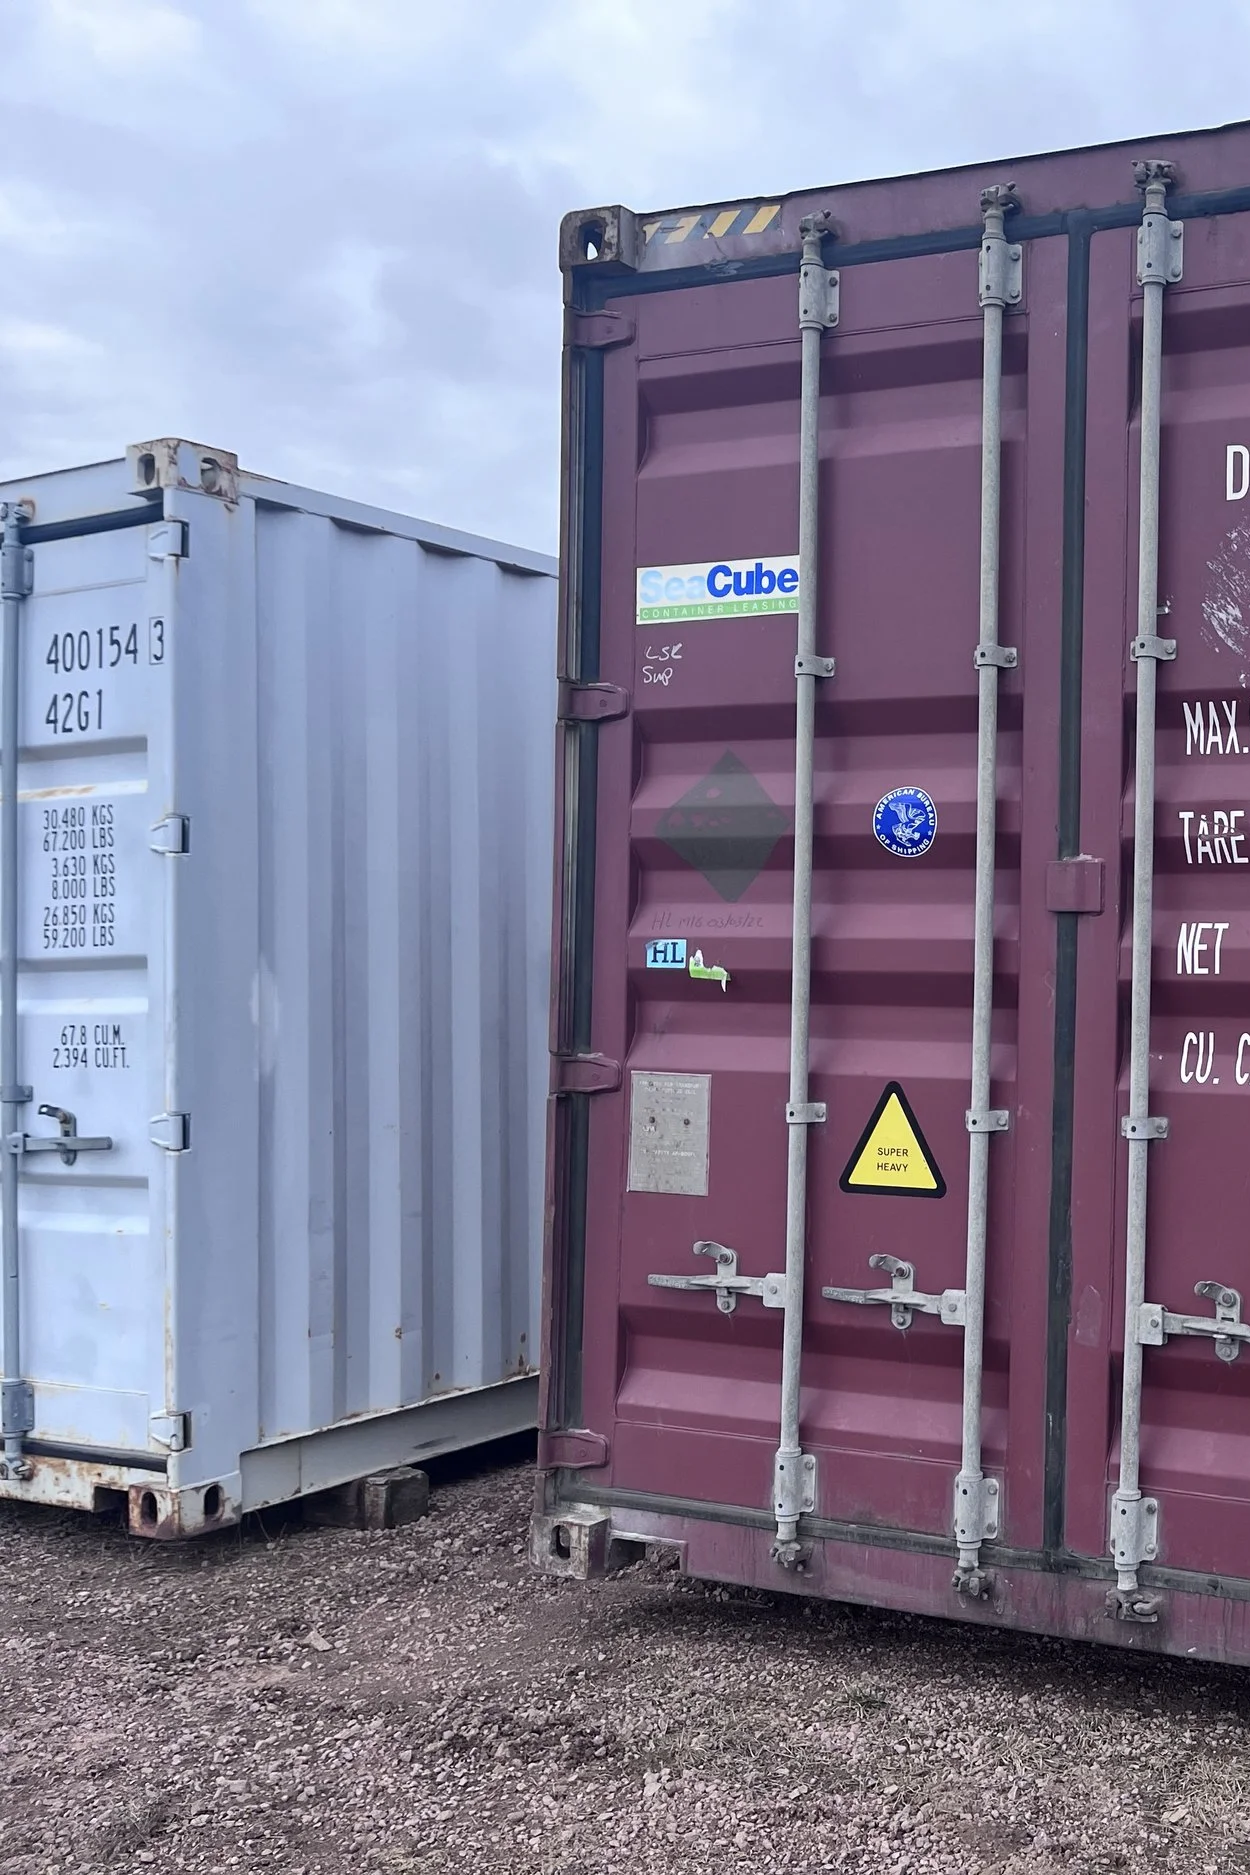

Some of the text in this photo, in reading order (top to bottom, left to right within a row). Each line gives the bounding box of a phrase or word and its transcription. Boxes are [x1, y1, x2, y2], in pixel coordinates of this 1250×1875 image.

[640, 562, 799, 603] SeaCube
[642, 600, 797, 619] CONTAINER LEASING
[46, 619, 164, 674] 400154 3
[45, 689, 103, 734] 42G1
[43, 804, 114, 830] 30.480 KGS
[876, 789, 935, 826] AMERICAN BUREAU
[43, 827, 115, 852] 67.200 LBS
[891, 838, 930, 855] SHIPPING
[1178, 810, 1249, 864] TARE
[51, 854, 115, 878] 3.630 KGS
[51, 876, 116, 900] 8.000 LBS
[43, 903, 115, 927] 26.850 KGS
[43, 926, 115, 950] 59.200 LBS
[1176, 922, 1230, 975] NET
[652, 941, 685, 964] HL
[60, 1024, 125, 1046] 67.8 CU.M.
[53, 1047, 130, 1069] 2.394 CU.FT.
[1180, 1031, 1220, 1086] CU.
[877, 1147, 908, 1157] SUPER
[876, 1162, 909, 1172] HEAVY
